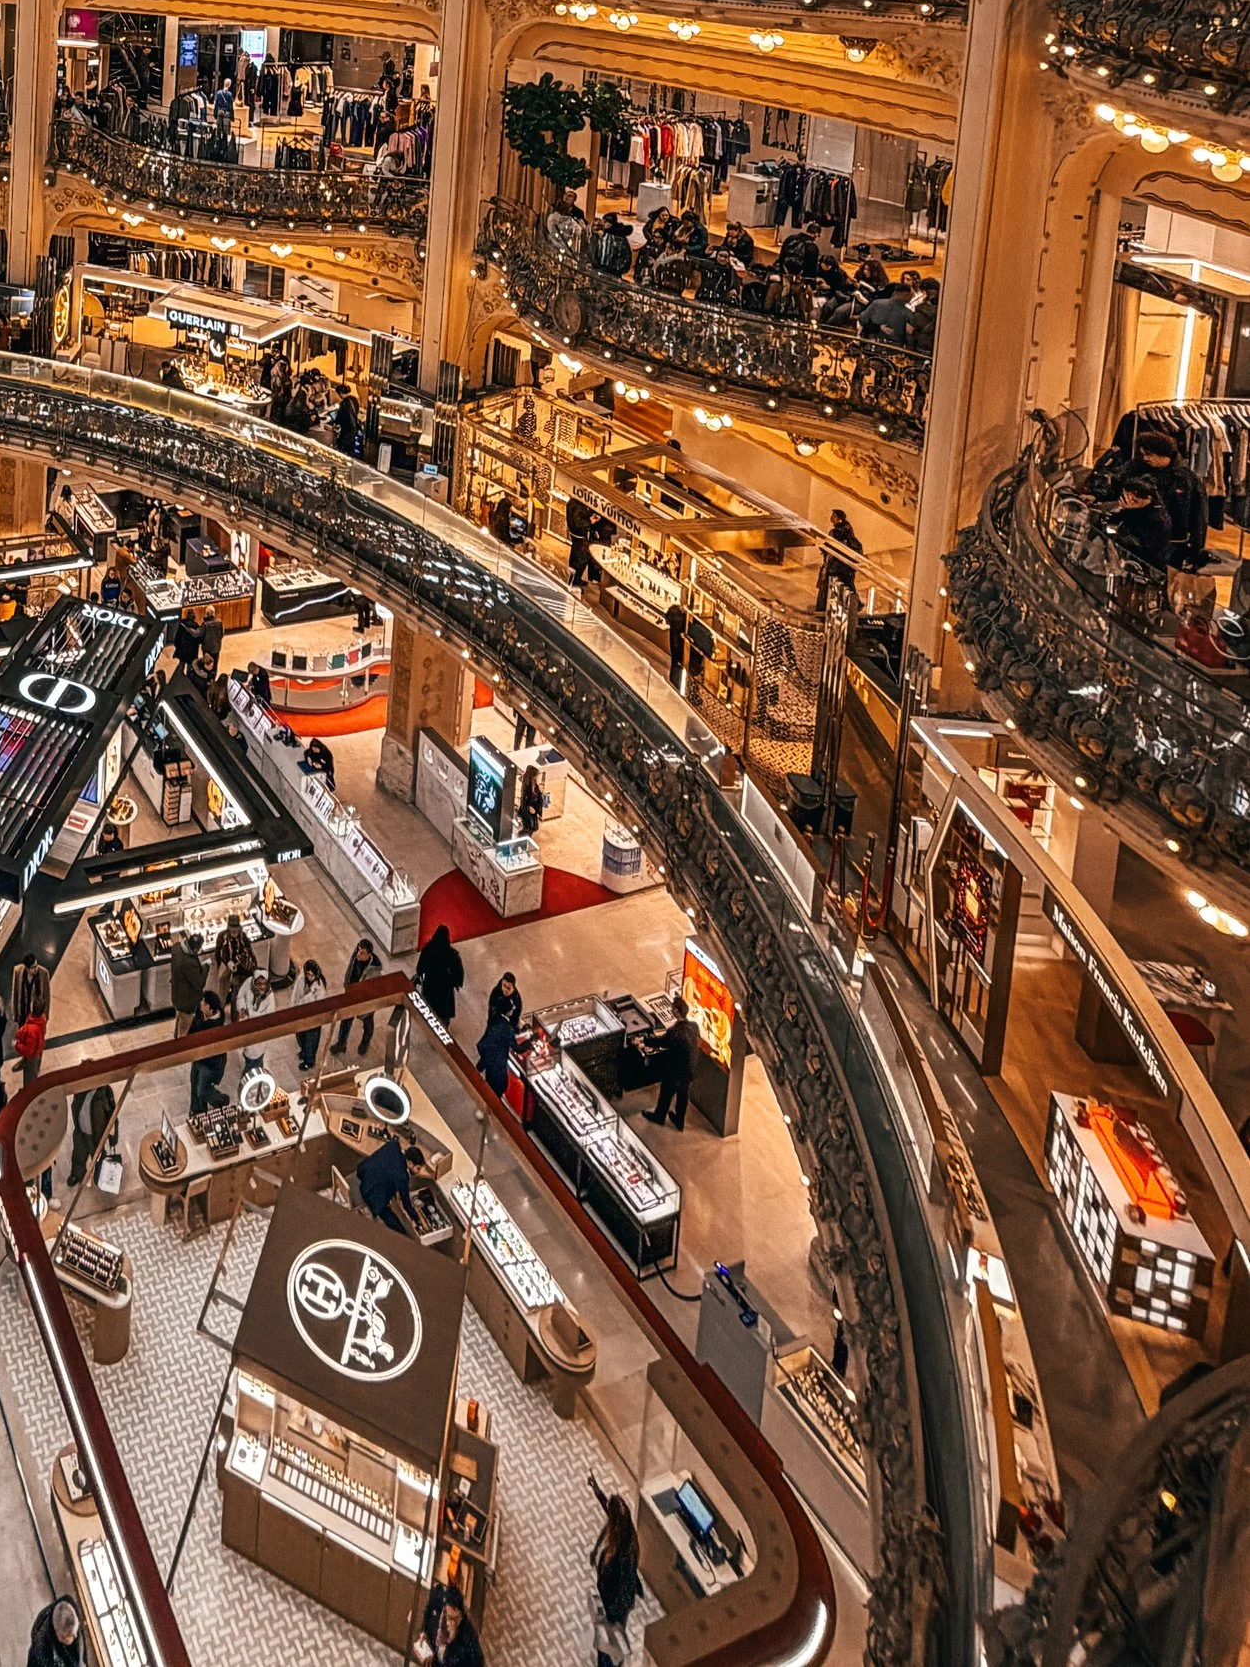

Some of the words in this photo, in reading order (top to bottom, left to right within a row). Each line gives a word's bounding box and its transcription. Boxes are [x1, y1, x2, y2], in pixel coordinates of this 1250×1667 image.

[169, 310, 226, 333] GUERLAIN
[572, 485, 600, 508] LOUIS
[600, 499, 642, 536] VUITTON
[81, 604, 138, 630] DIOR
[23, 826, 54, 892] DIOR
[277, 849, 302, 863] DIOR
[1053, 904, 1087, 963] Maison
[1087, 955, 1123, 1017] Francis
[1122, 1007, 1168, 1098] Kurkdjian
